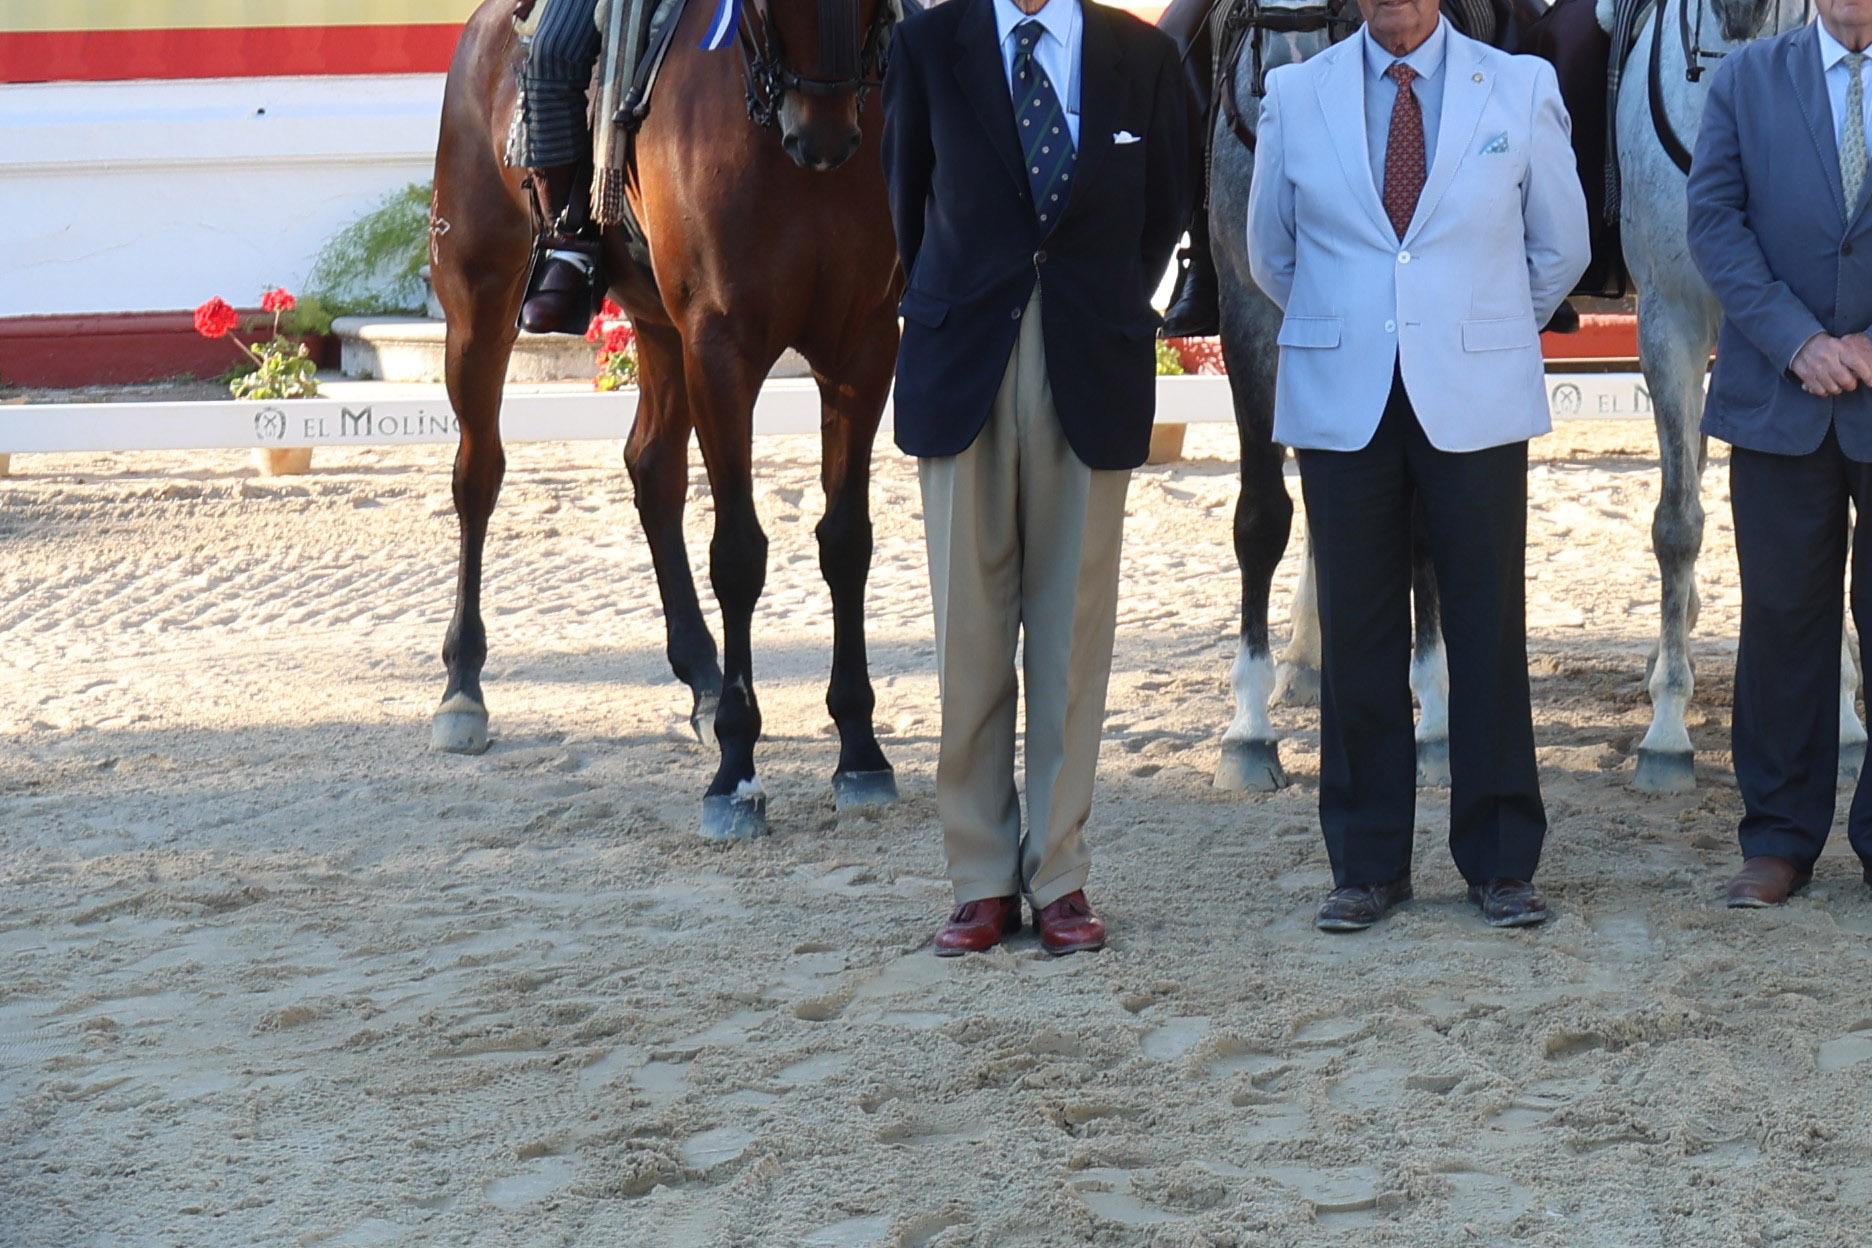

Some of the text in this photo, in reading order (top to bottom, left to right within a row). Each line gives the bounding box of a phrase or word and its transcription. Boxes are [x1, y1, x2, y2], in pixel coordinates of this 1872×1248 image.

[1598, 393, 1621, 413] EL
[303, 405, 460, 438] EL MOLIN
